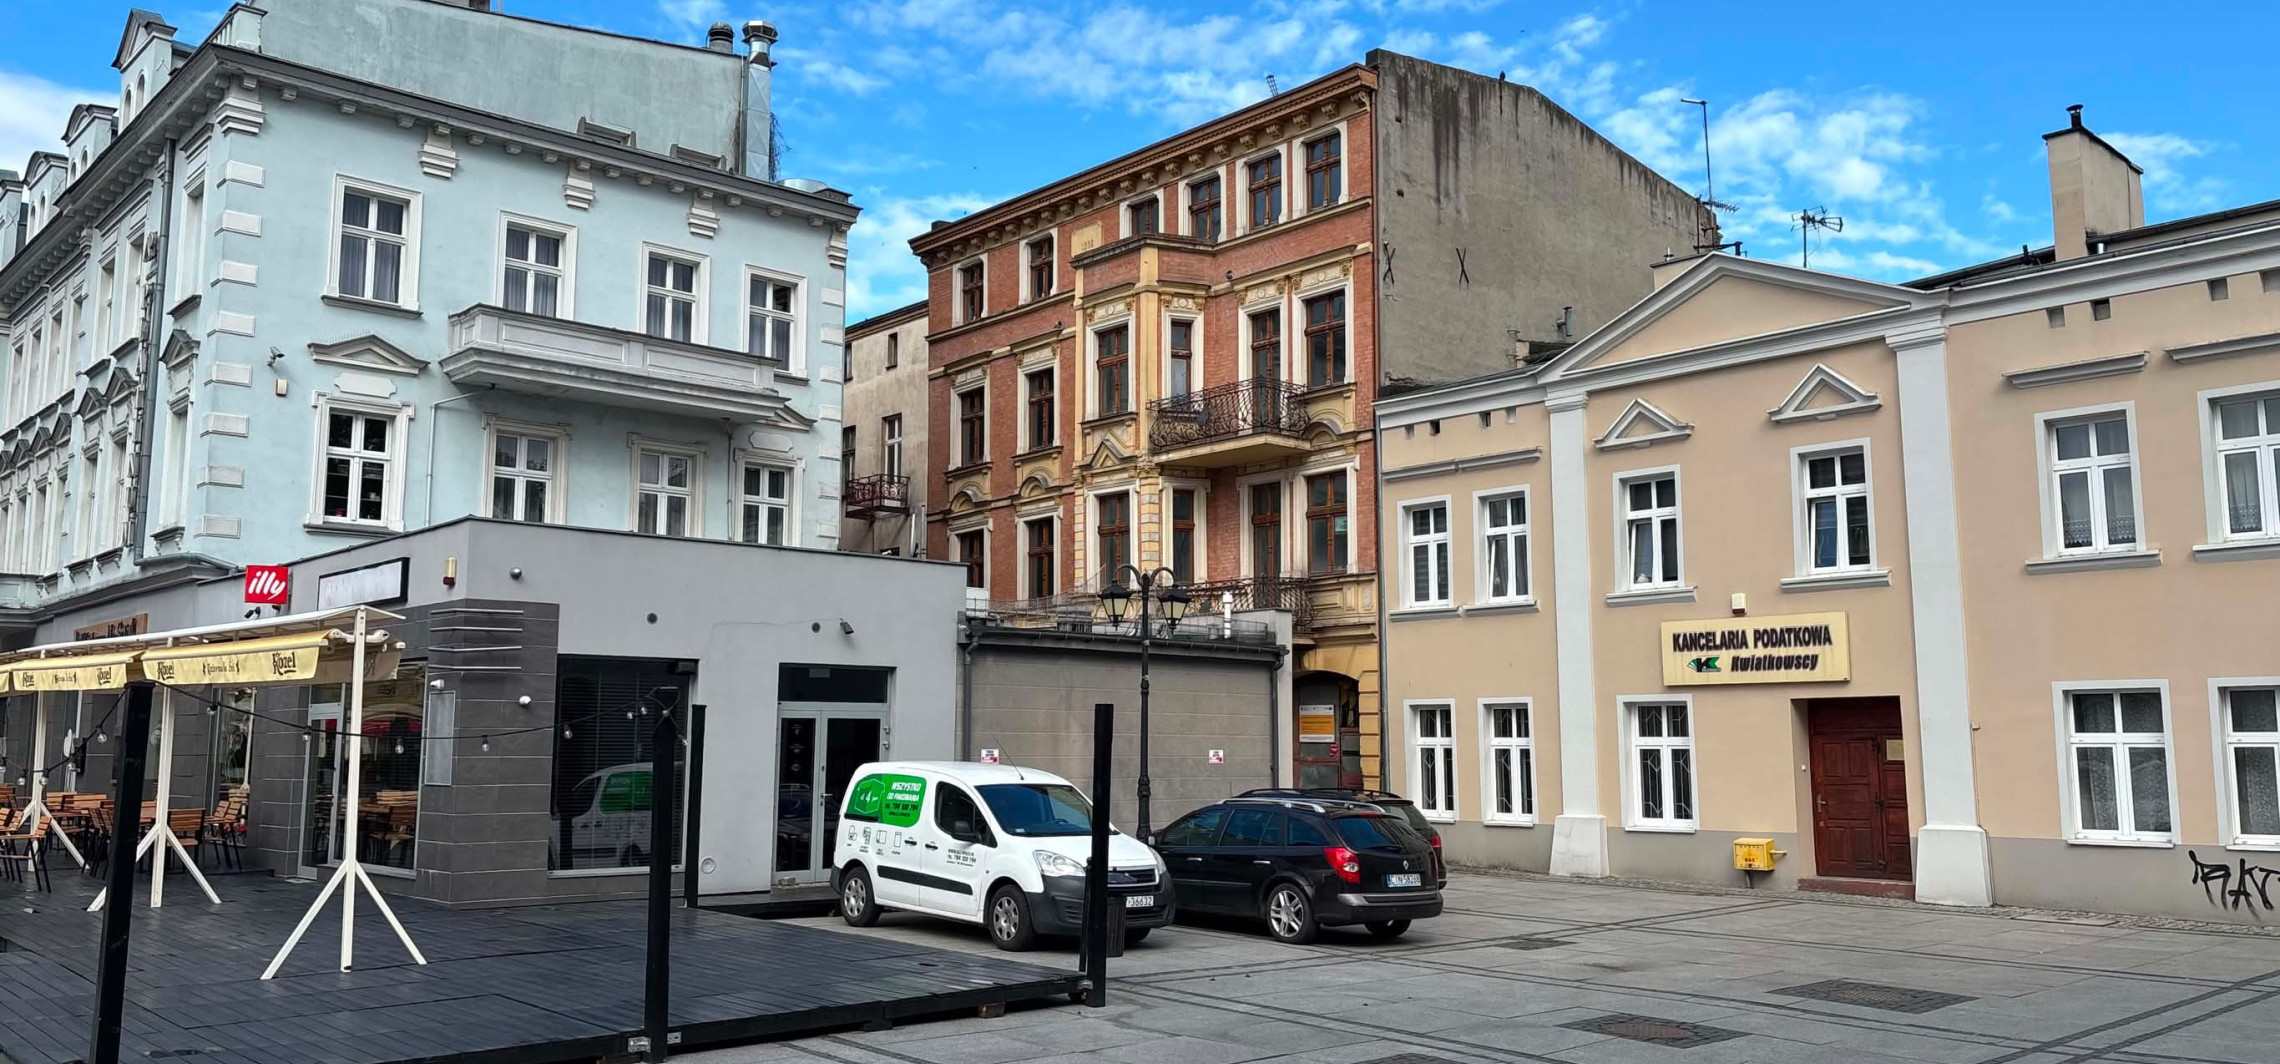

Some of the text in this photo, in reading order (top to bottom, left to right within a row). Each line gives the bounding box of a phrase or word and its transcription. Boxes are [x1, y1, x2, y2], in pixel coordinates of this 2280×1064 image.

[248, 570, 286, 600] illy
[1672, 624, 1833, 653] KANCELARIA PODATKOWA
[272, 652, 297, 675] Kozel
[1731, 654, 1819, 672] Kwiatkowscy
